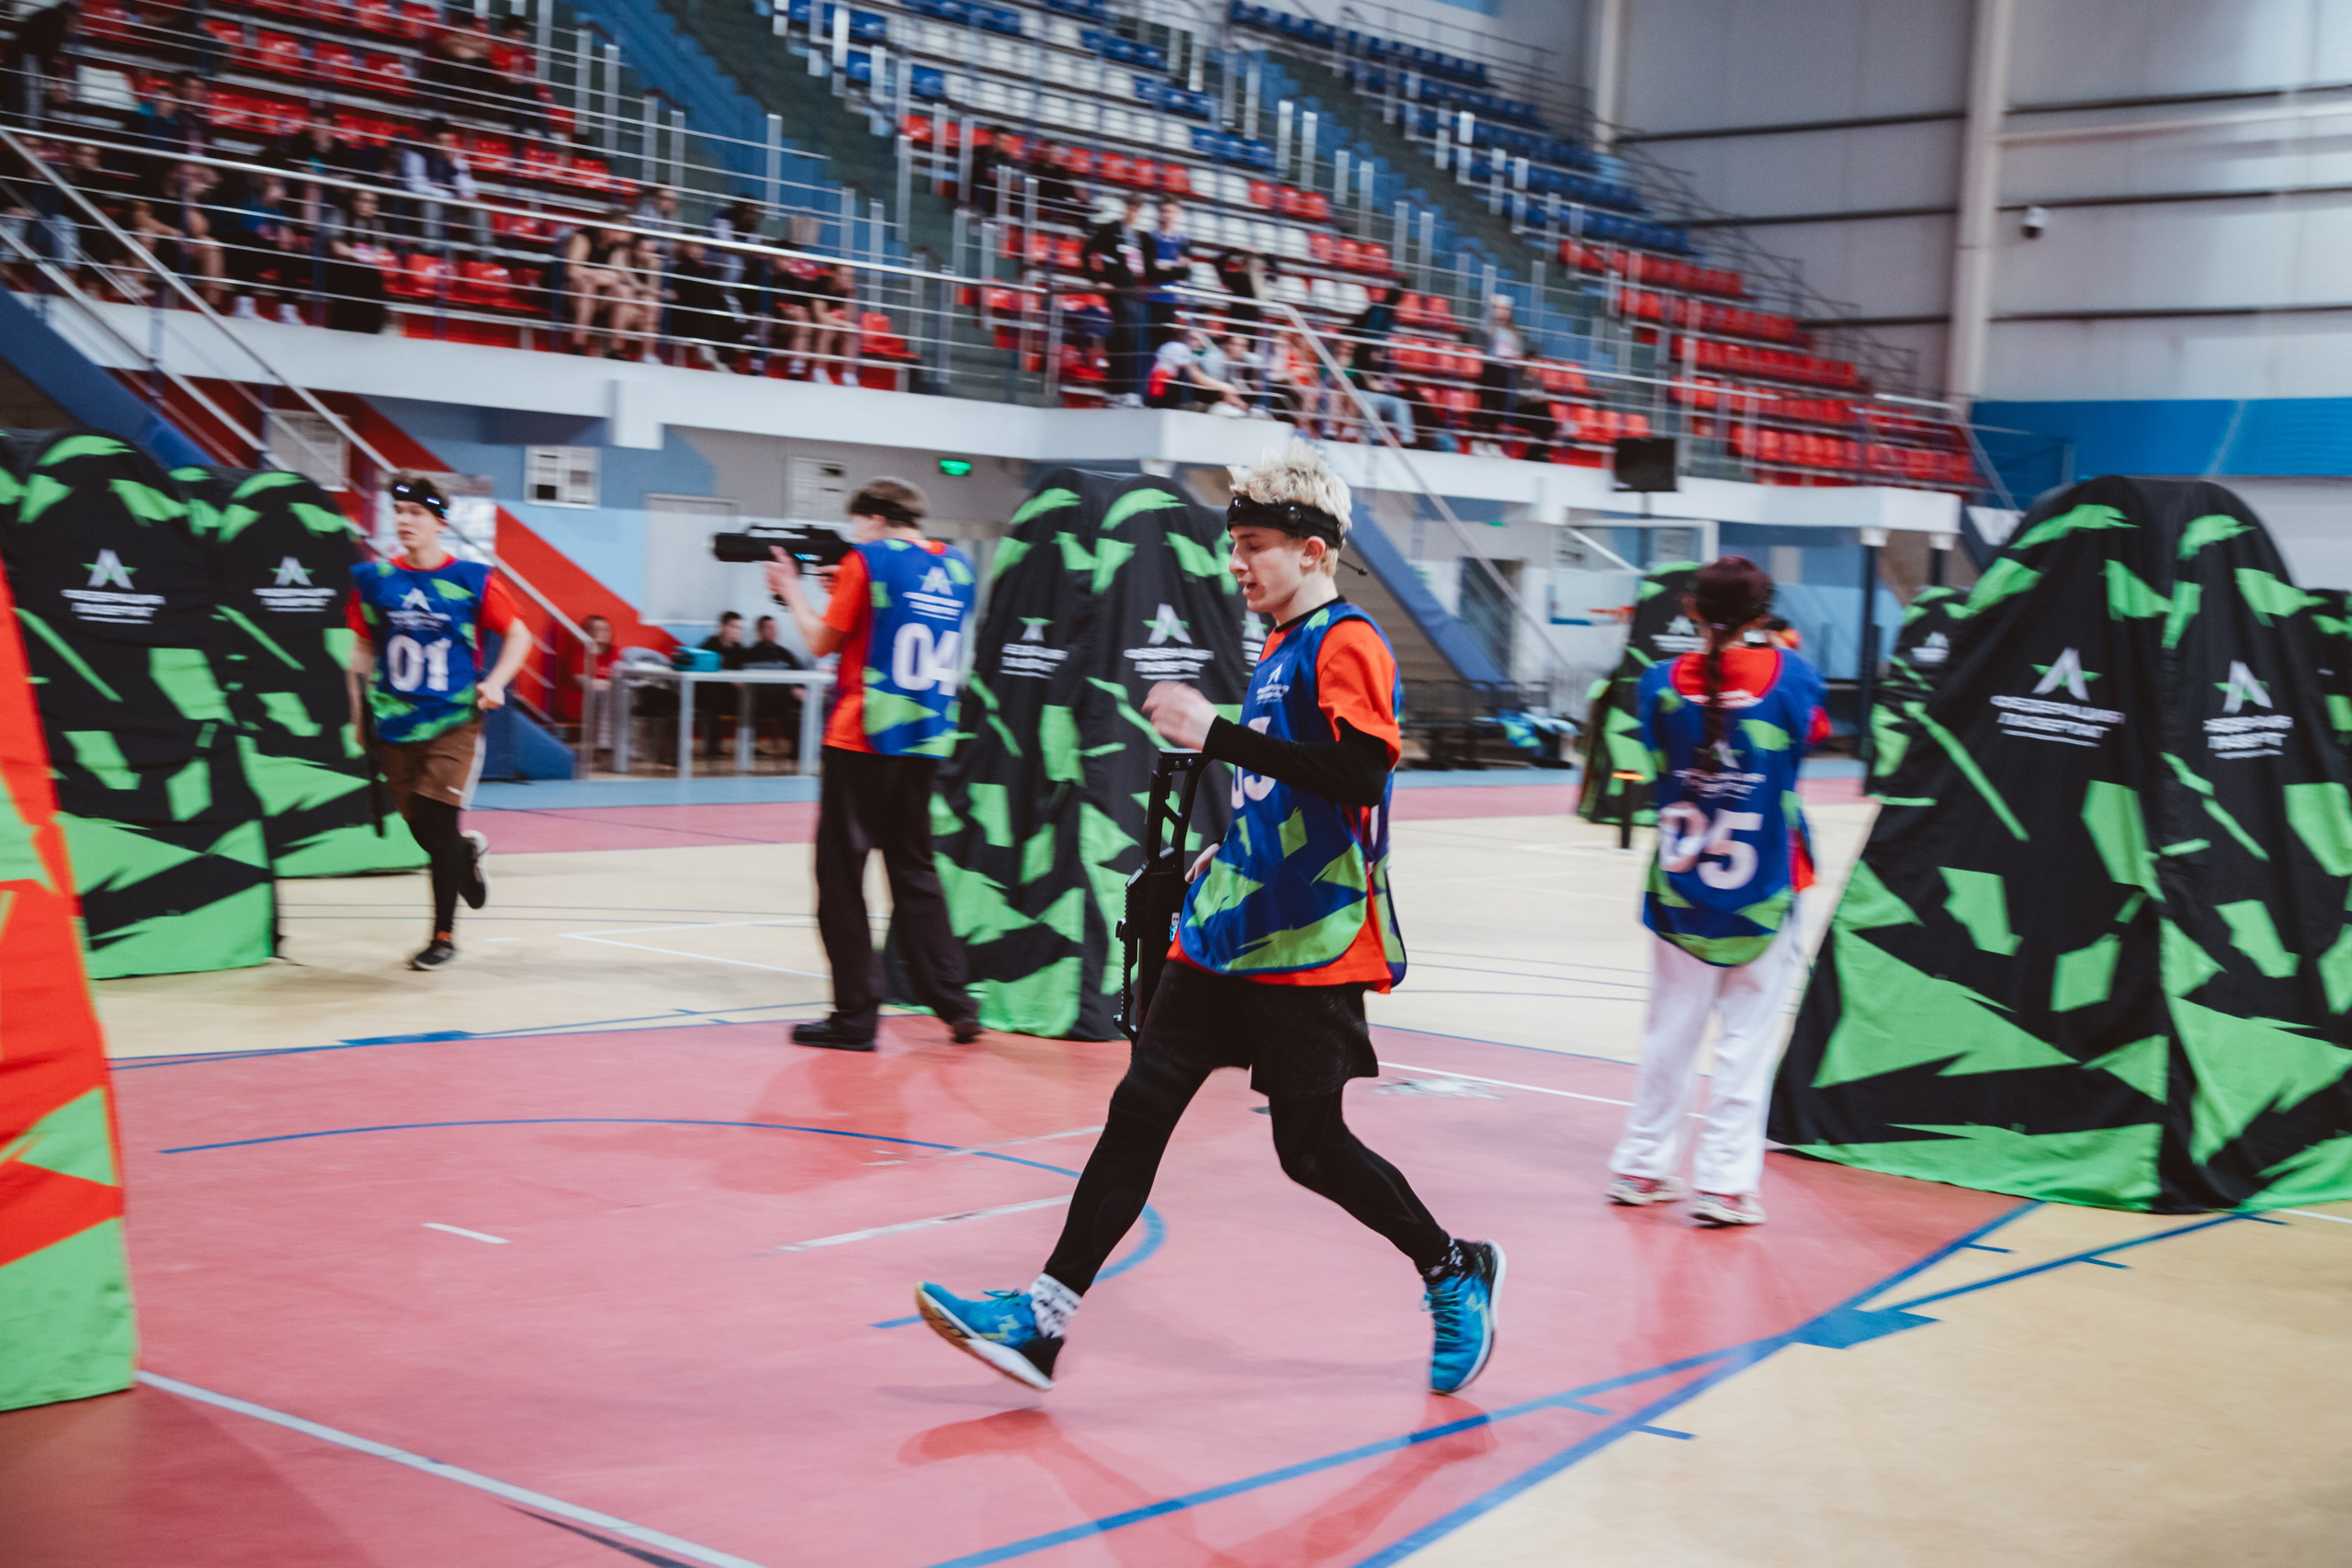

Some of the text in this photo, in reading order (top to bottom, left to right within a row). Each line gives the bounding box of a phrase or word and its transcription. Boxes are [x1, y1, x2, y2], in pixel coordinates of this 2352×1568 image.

[387, 634, 451, 692] 01
[892, 623, 965, 696] 04
[1659, 801, 1764, 890] 05
